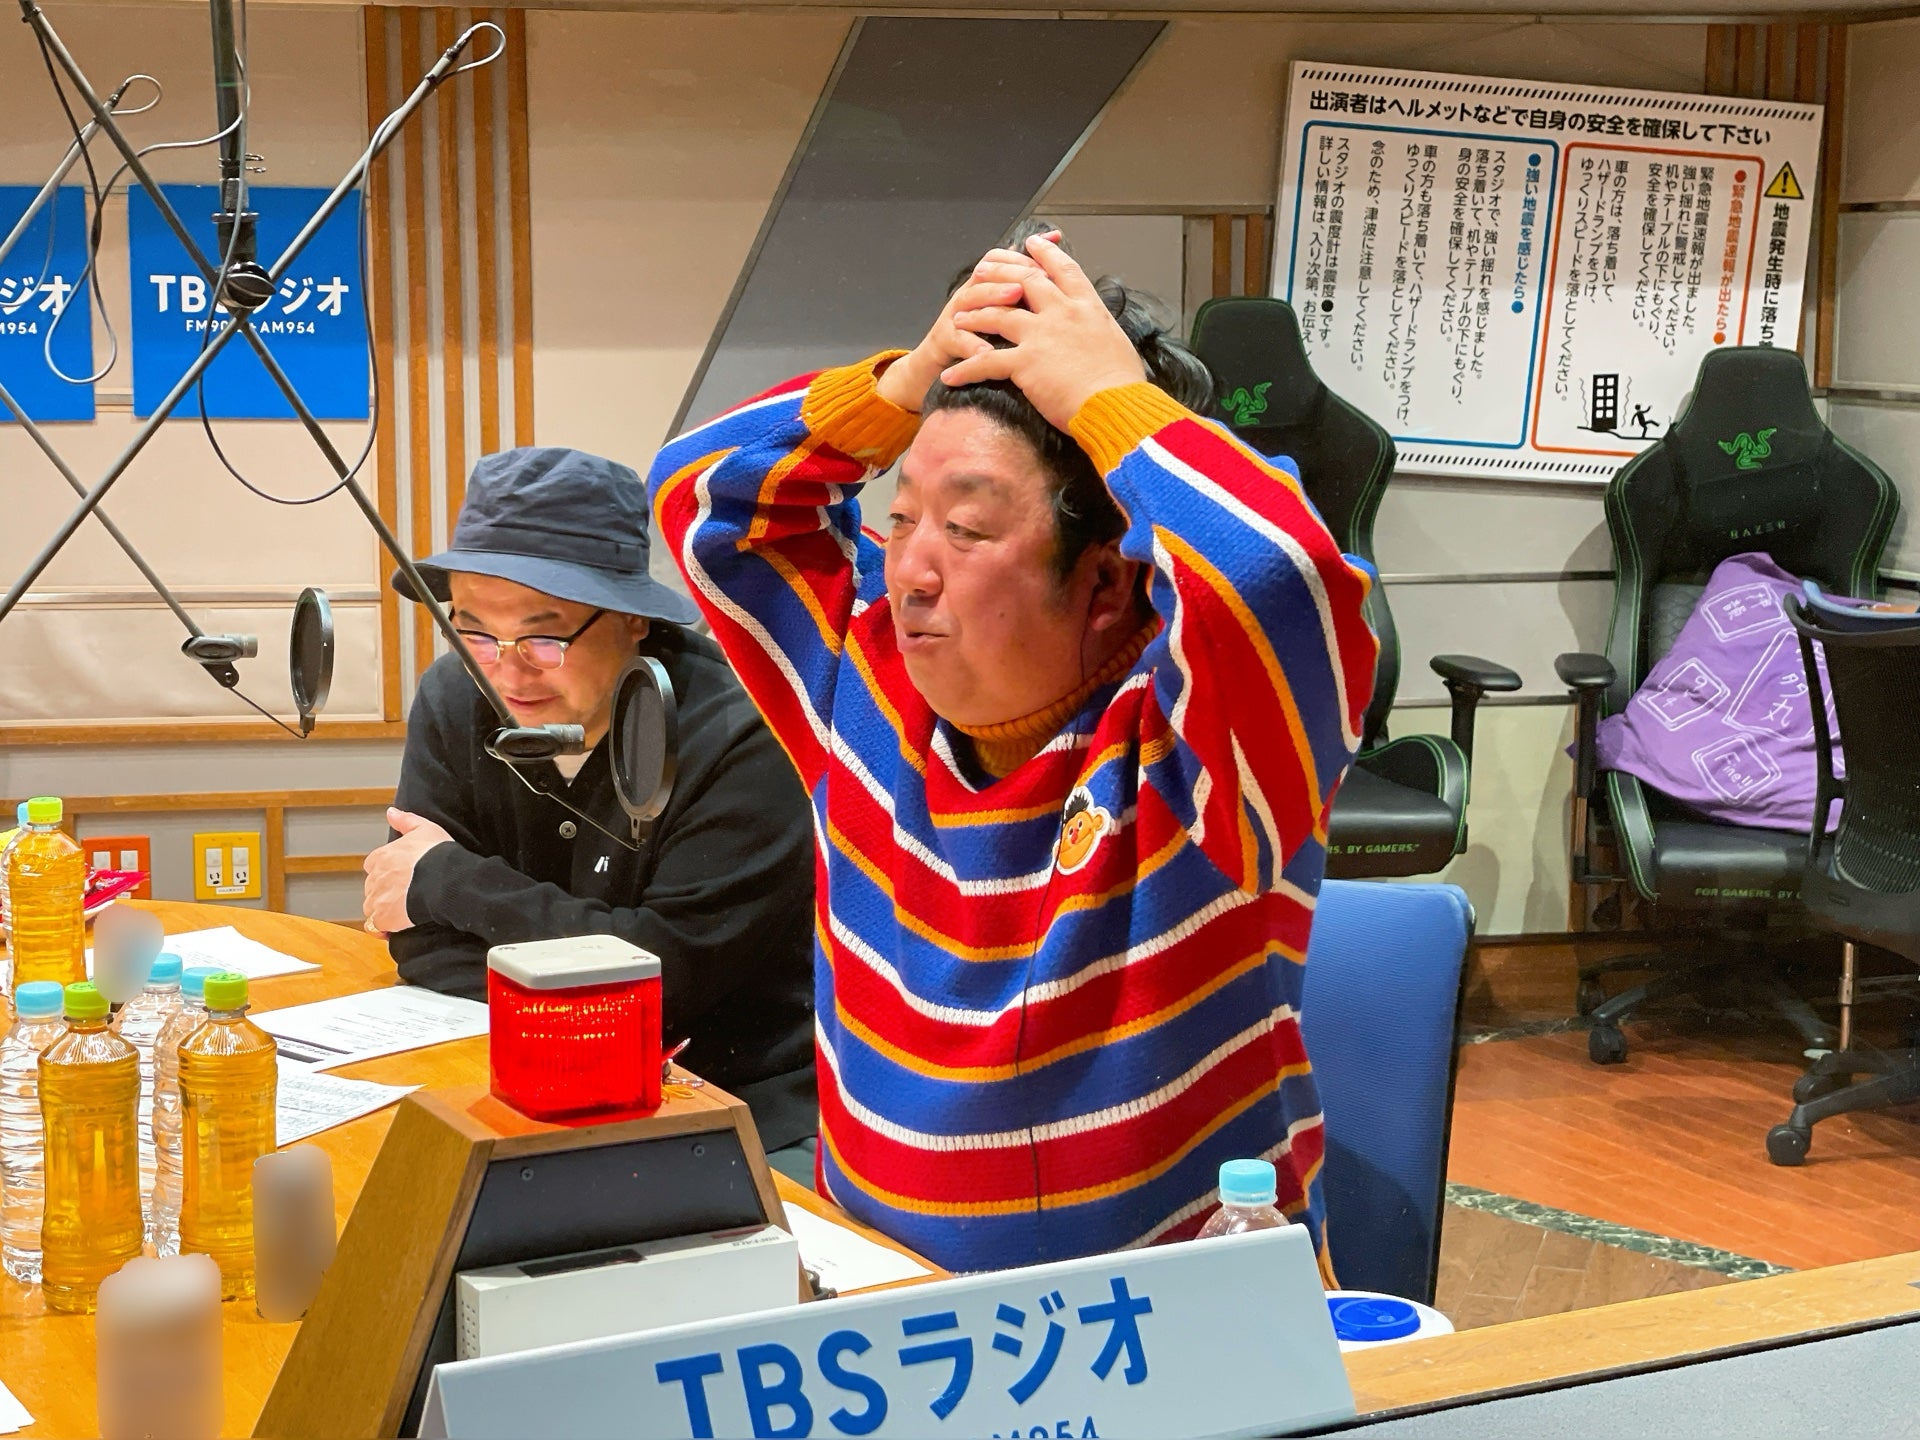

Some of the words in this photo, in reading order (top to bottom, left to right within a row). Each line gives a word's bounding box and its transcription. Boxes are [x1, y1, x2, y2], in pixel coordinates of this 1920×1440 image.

[1309, 89, 1771, 145] 出演者はヘルメットなどで自身の安全を確保して下さい
[149, 274, 350, 317] TBジオ
[1350, 139, 1386, 372] 念のため、津波に注意してください。
[1383, 143, 1421, 390] ゆっくりスピードを落としてください。
[1396, 144, 1439, 426] 車の方も落ち着いて、ハザードランプをつけ、
[1440, 147, 1472, 342] 身の安全を確保してください。
[1451, 148, 1490, 404] 落ち着いて、机やテーブルの下にもぐり、
[1470, 150, 1506, 380] スタジオで、強い揺れを感じました。
[1555, 157, 1595, 401] ゆっくりスピードを落としてください。
[1583, 158, 1611, 304] ハザードランプをつけ、
[1601, 160, 1629, 303] 車の方は、落ち着いて、
[1632, 162, 1663, 328] 安全を確保してください。
[1649, 163, 1680, 341] 机やテーブルの下にもぐり、
[1663, 165, 1698, 356] 強い揺れに警戒してください。
[1682, 166, 1715, 335] 緊急地震速報が出ました。
[1759, 202, 1790, 347] 地震発生時に落ち
[259, 321, 316, 335] AM954
[1346, 845, 1362, 854] BY
[1695, 887, 1719, 897] FOR
[1777, 890, 1794, 899] BY
[655, 1276, 1153, 1439] TBSラジオ
